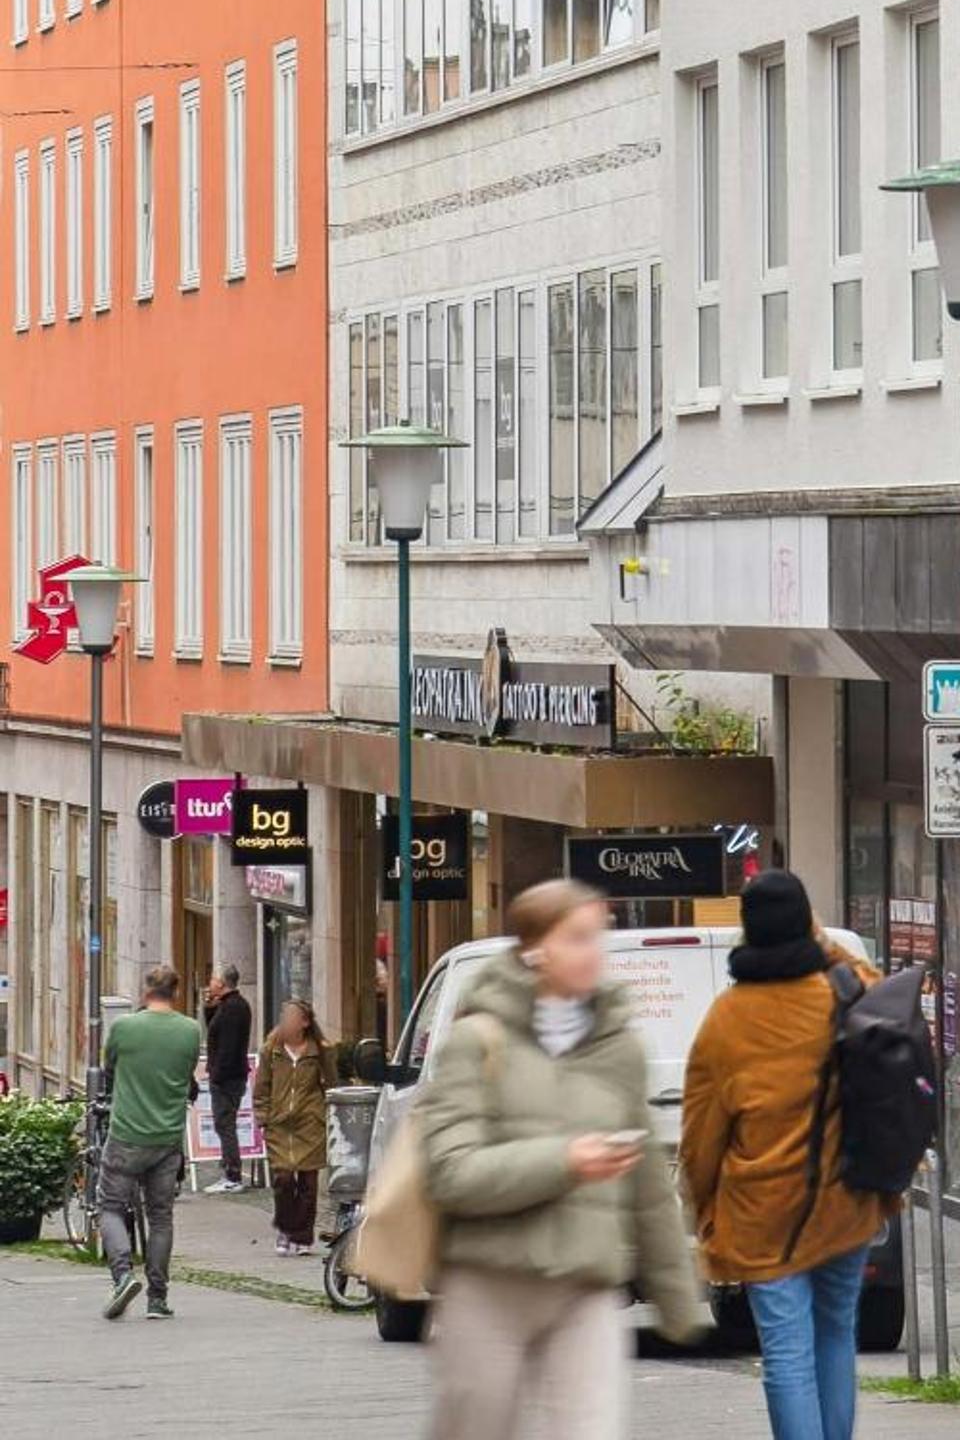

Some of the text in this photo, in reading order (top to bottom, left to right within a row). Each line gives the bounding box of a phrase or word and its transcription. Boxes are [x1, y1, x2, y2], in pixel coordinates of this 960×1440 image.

[412, 668, 462, 722] LEOPATRA
[252, 803, 291, 836] bg
[235, 836, 305, 849] design optic
[629, 862, 663, 880] INK
